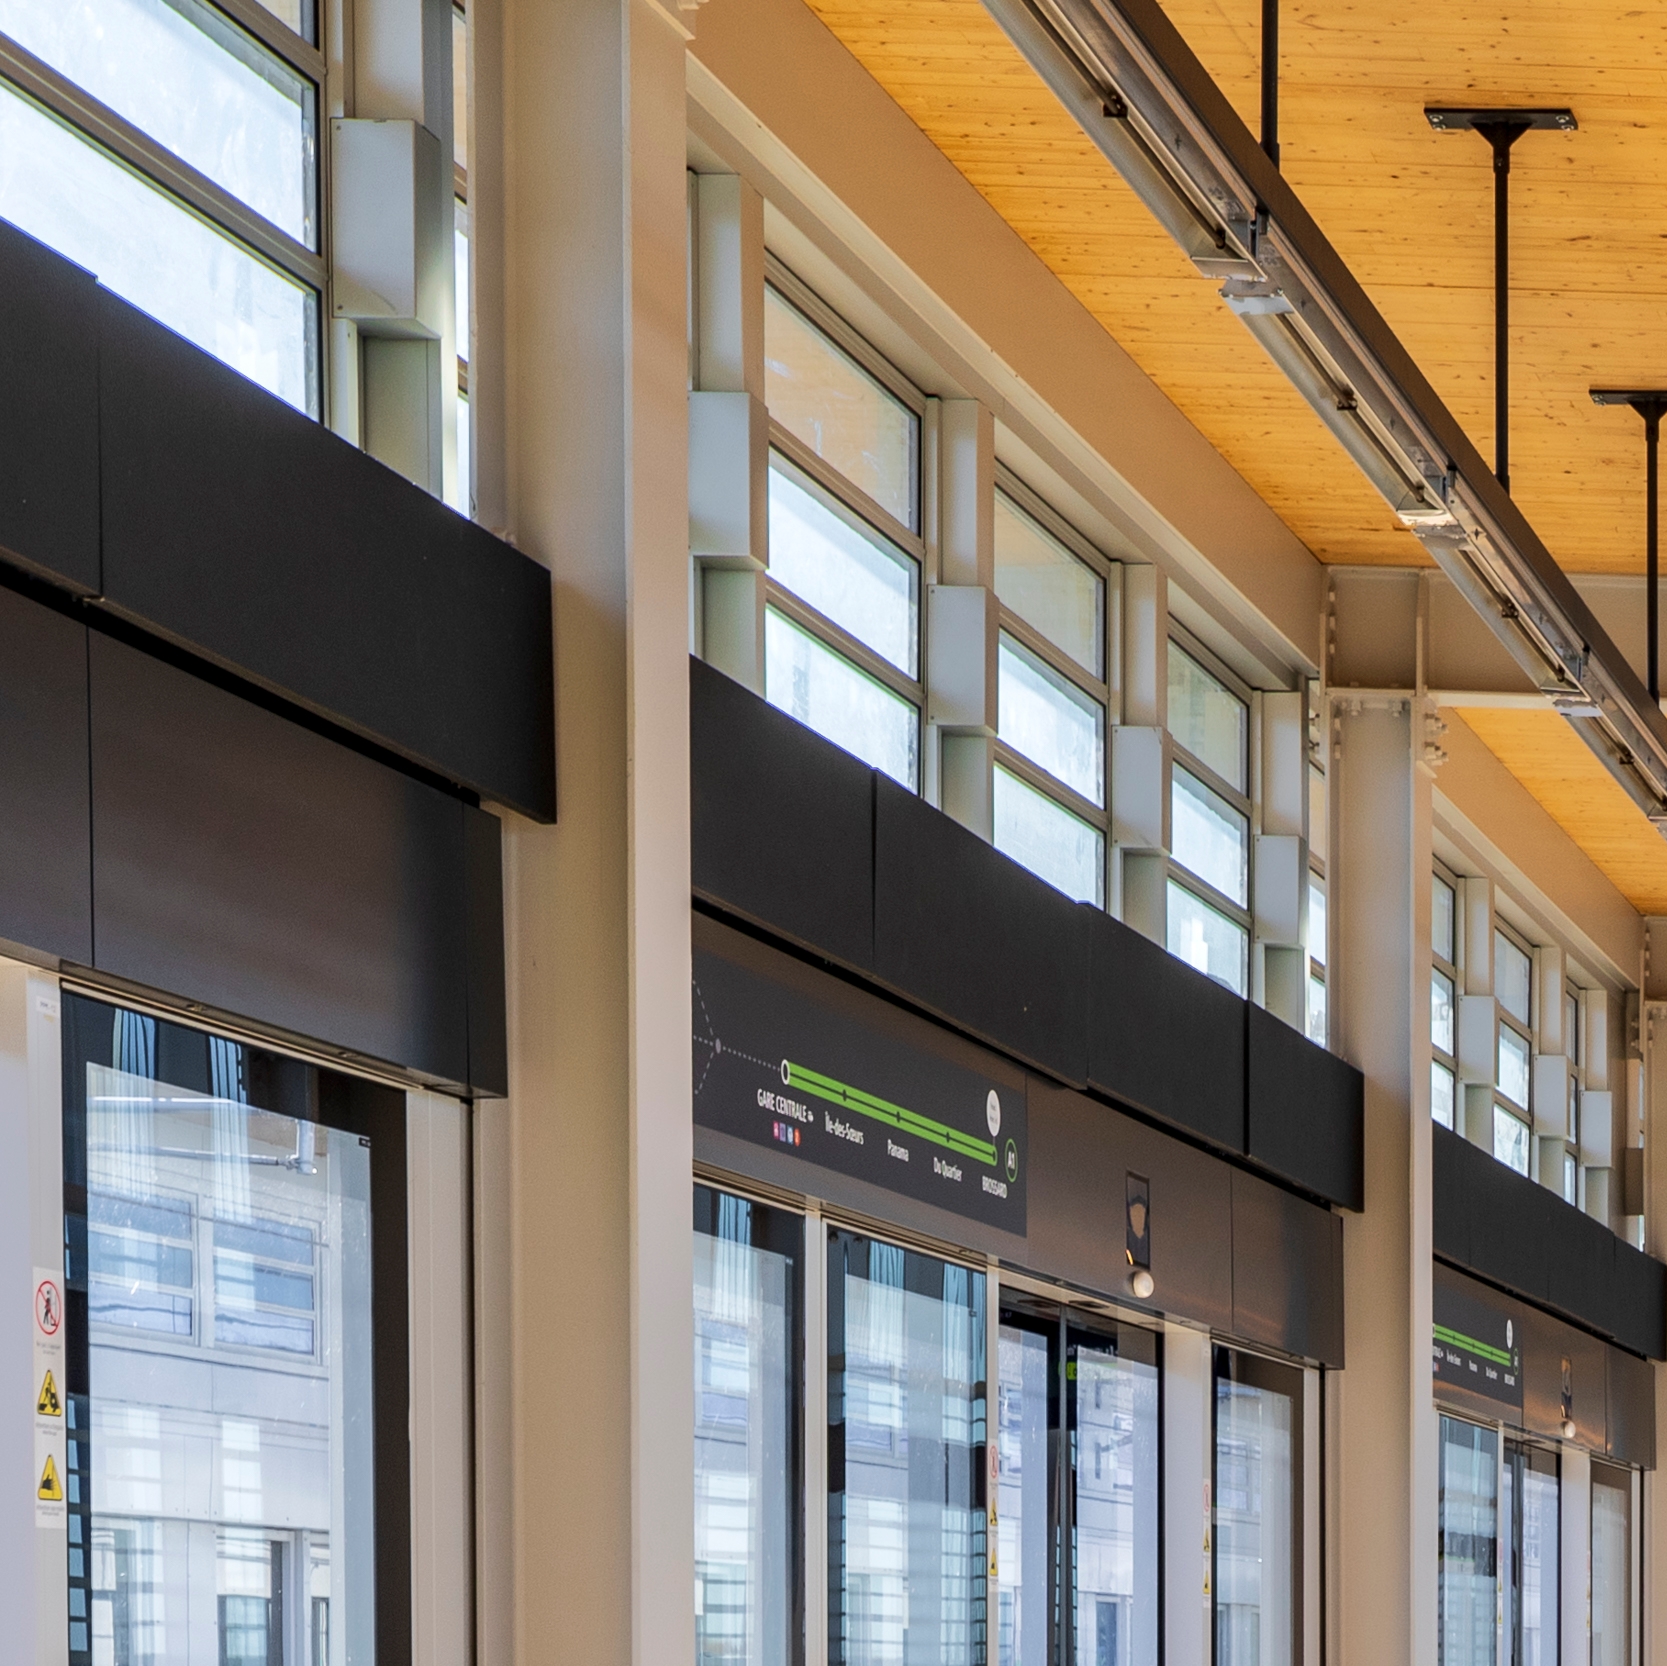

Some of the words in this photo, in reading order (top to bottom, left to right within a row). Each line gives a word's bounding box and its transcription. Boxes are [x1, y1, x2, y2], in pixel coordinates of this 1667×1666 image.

[757, 1088, 775, 1111] GARE
[776, 1095, 807, 1122] CENTRALE
[887, 1138, 909, 1162] Panama
[941, 1159, 962, 1182] Quartier
[982, 1175, 1007, 1199] BROSSARD
